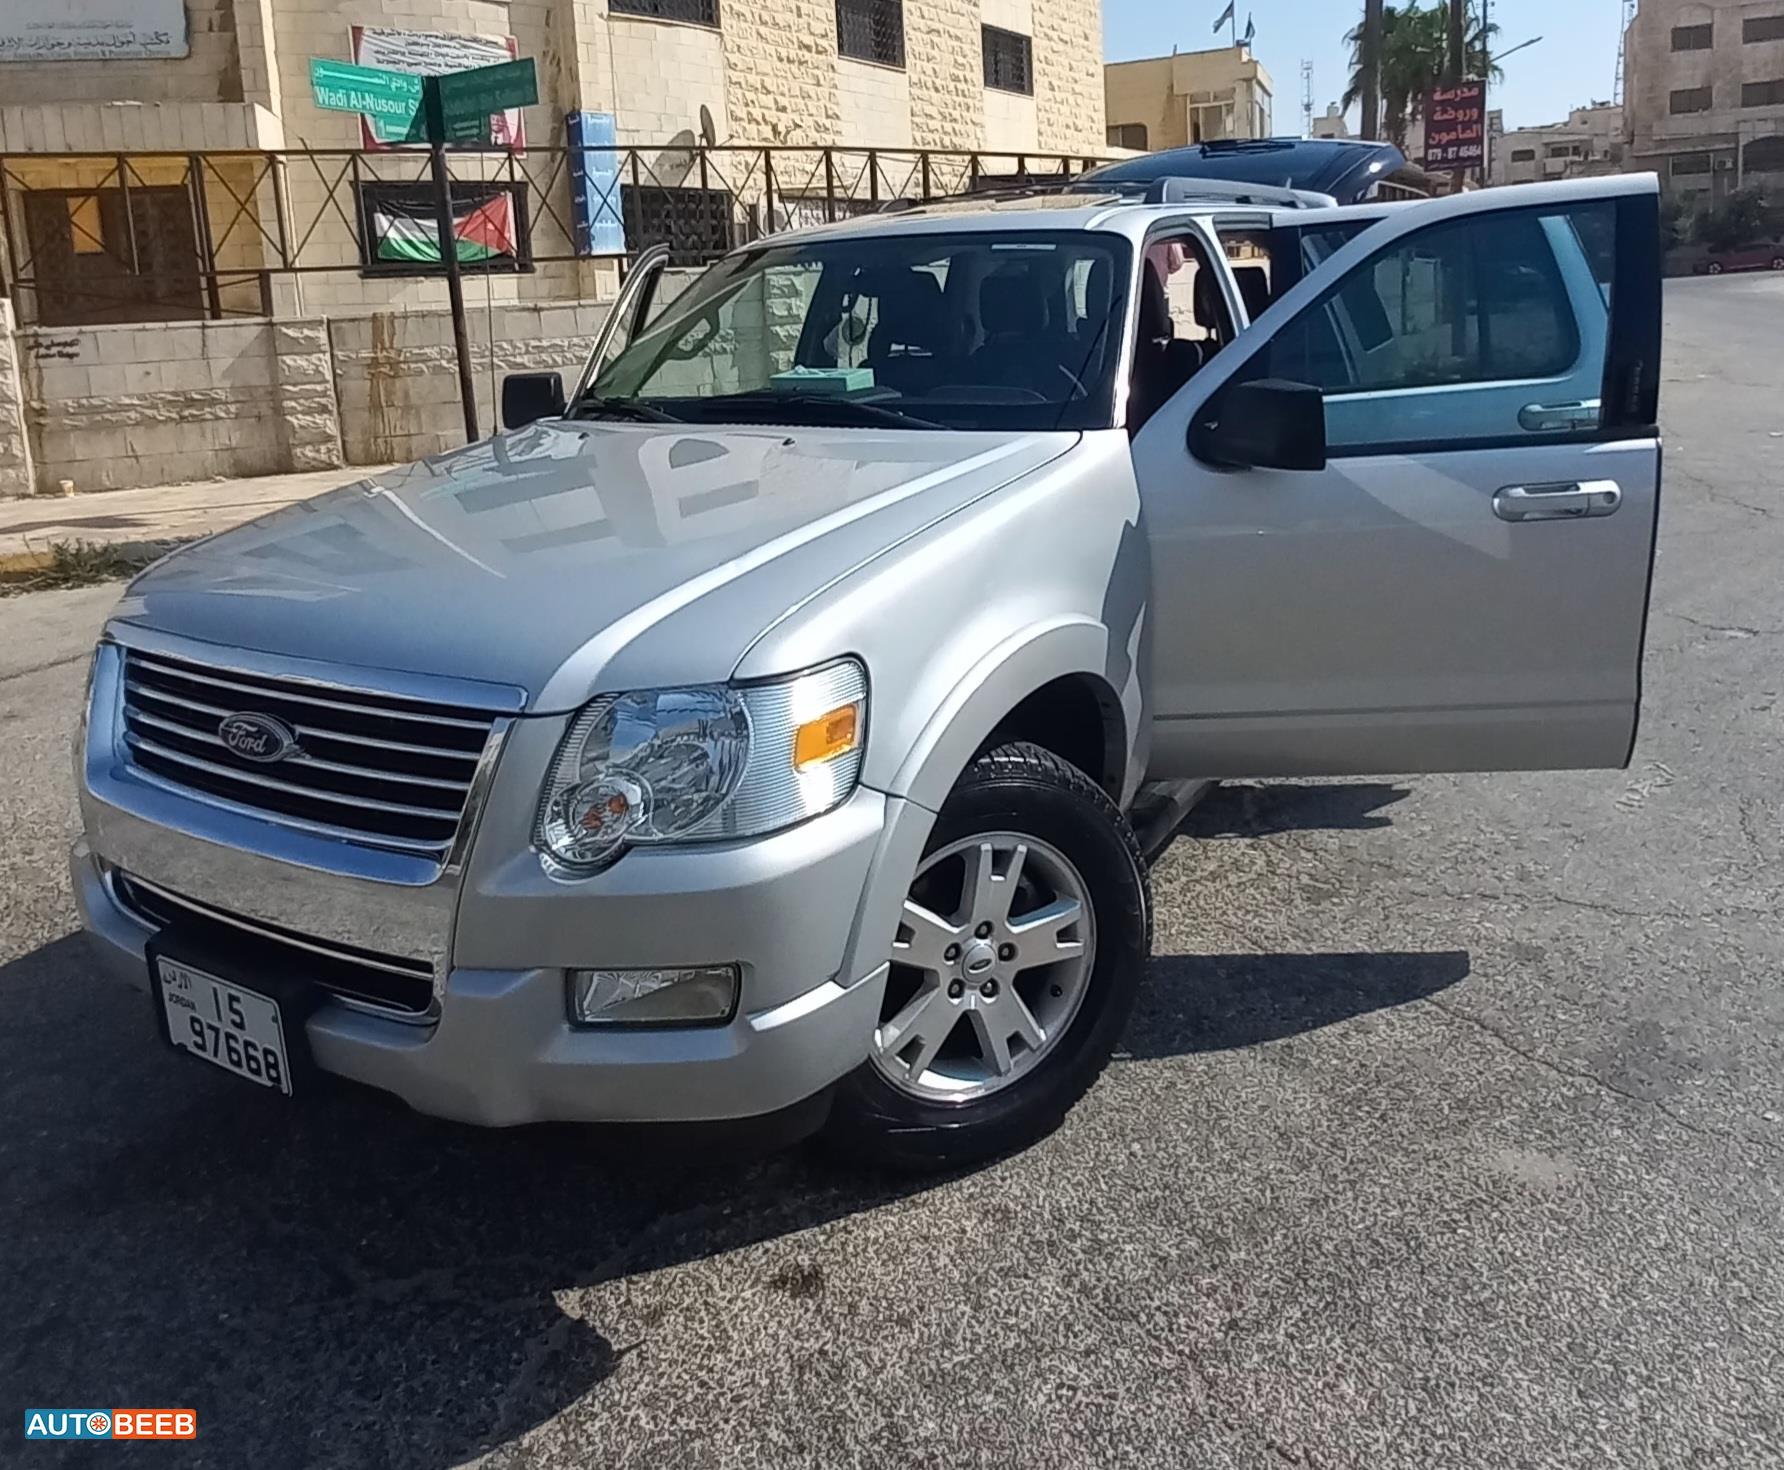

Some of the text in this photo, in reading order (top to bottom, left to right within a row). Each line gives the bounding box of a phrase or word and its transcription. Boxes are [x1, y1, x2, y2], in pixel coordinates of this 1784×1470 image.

[314, 85, 348, 108] Wadi
[350, 90, 407, 114] Al-Nusour
[222, 722, 268, 753] Ford
[212, 986, 246, 1032] 15
[189, 1014, 283, 1086] 97668
